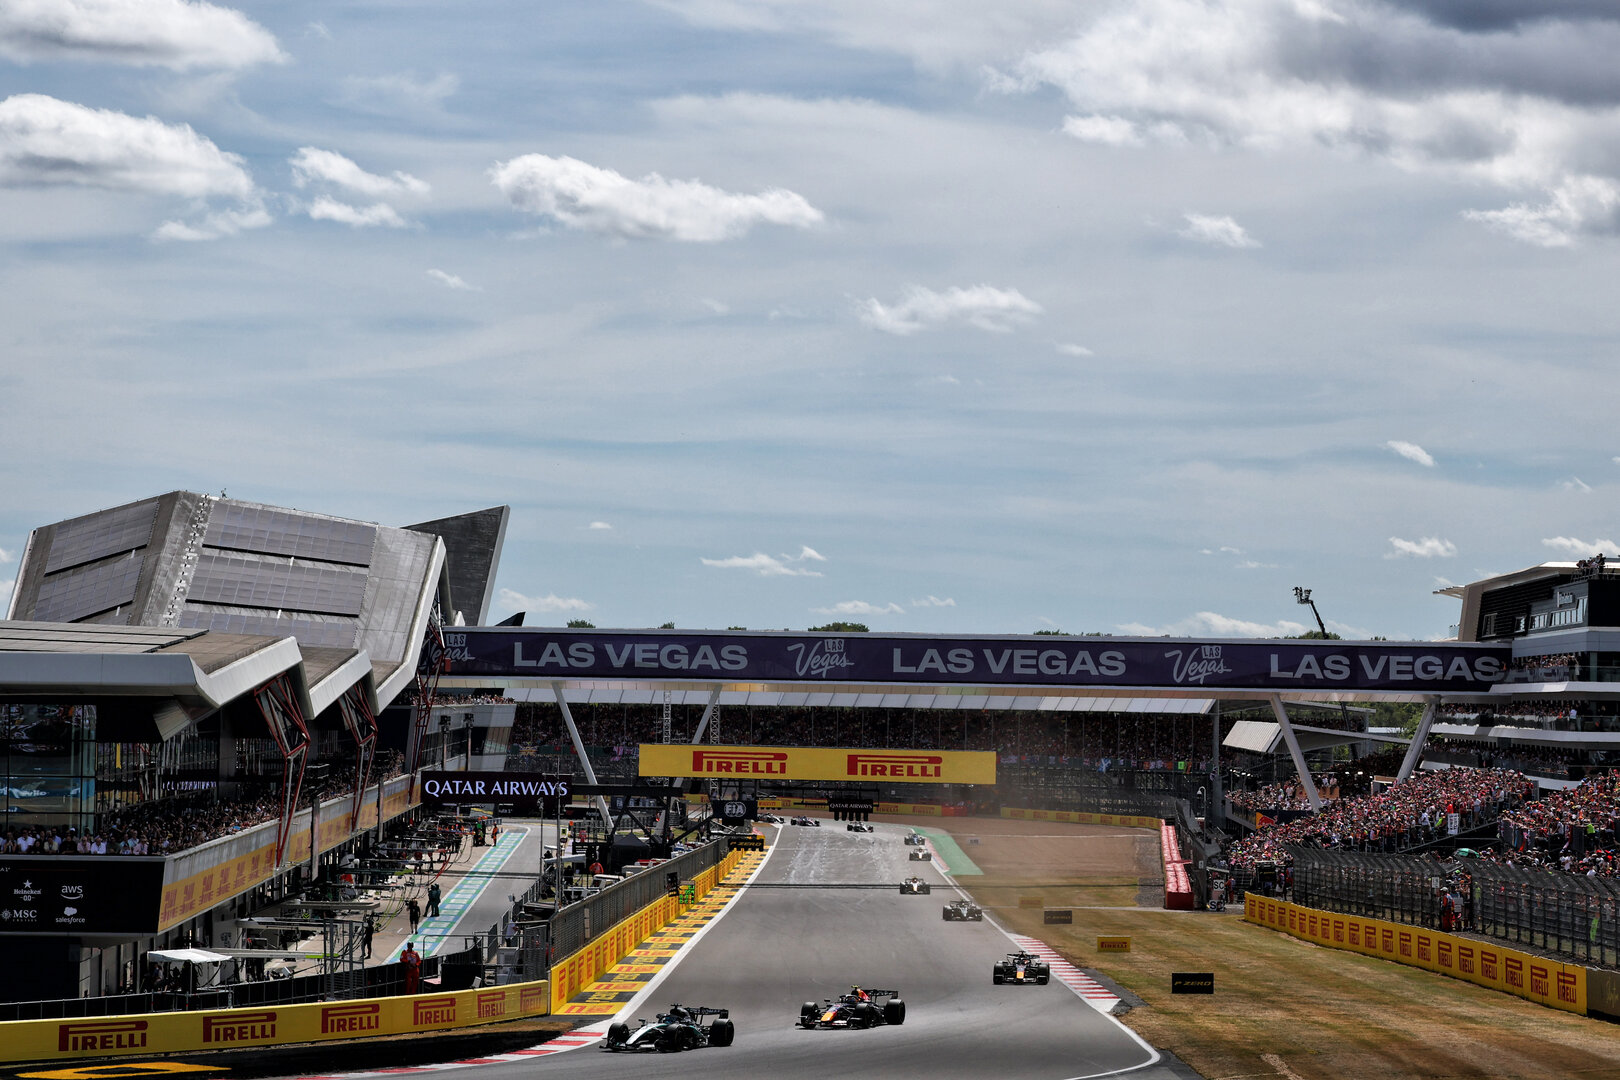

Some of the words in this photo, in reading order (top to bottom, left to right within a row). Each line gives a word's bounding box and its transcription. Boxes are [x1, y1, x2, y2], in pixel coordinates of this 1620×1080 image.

[446, 634, 466, 646] LAS
[824, 639, 845, 652] LAS
[1201, 646, 1221, 659] LAS
[513, 642, 595, 668] LAS
[604, 644, 748, 671] VEGAS
[787, 643, 854, 678] Vegas
[893, 648, 974, 673] LAS
[982, 649, 1126, 676] VEGAS
[1164, 650, 1232, 683] Vegas
[1270, 653, 1350, 680] LAS
[1358, 655, 1501, 682] VEGAS
[692, 750, 788, 774] PIRELLI
[847, 754, 943, 778] PIRELLI
[425, 780, 485, 797] QATAR
[490, 780, 568, 797] AIRWAYS
[725, 804, 744, 814] FIA
[61, 885, 83, 894] aws
[1213, 881, 1224, 890] SC
[13, 910, 37, 918] MSC
[1100, 941, 1128, 949] PIRELLI
[1459, 946, 1474, 974] PIRELLI
[1481, 950, 1497, 980] PIRELLI
[1505, 957, 1523, 988] PIRELLI
[1530, 965, 1548, 996] PIRELLI
[1556, 971, 1576, 1004] PIRELLI
[413, 997, 456, 1026] PIRELLI
[477, 991, 505, 1019] PIRELLI
[520, 986, 542, 1013] PIRELLI
[202, 1012, 277, 1043] PIRELLI
[321, 1003, 380, 1034] PIRELLI
[58, 1020, 148, 1051] PIRELLI
